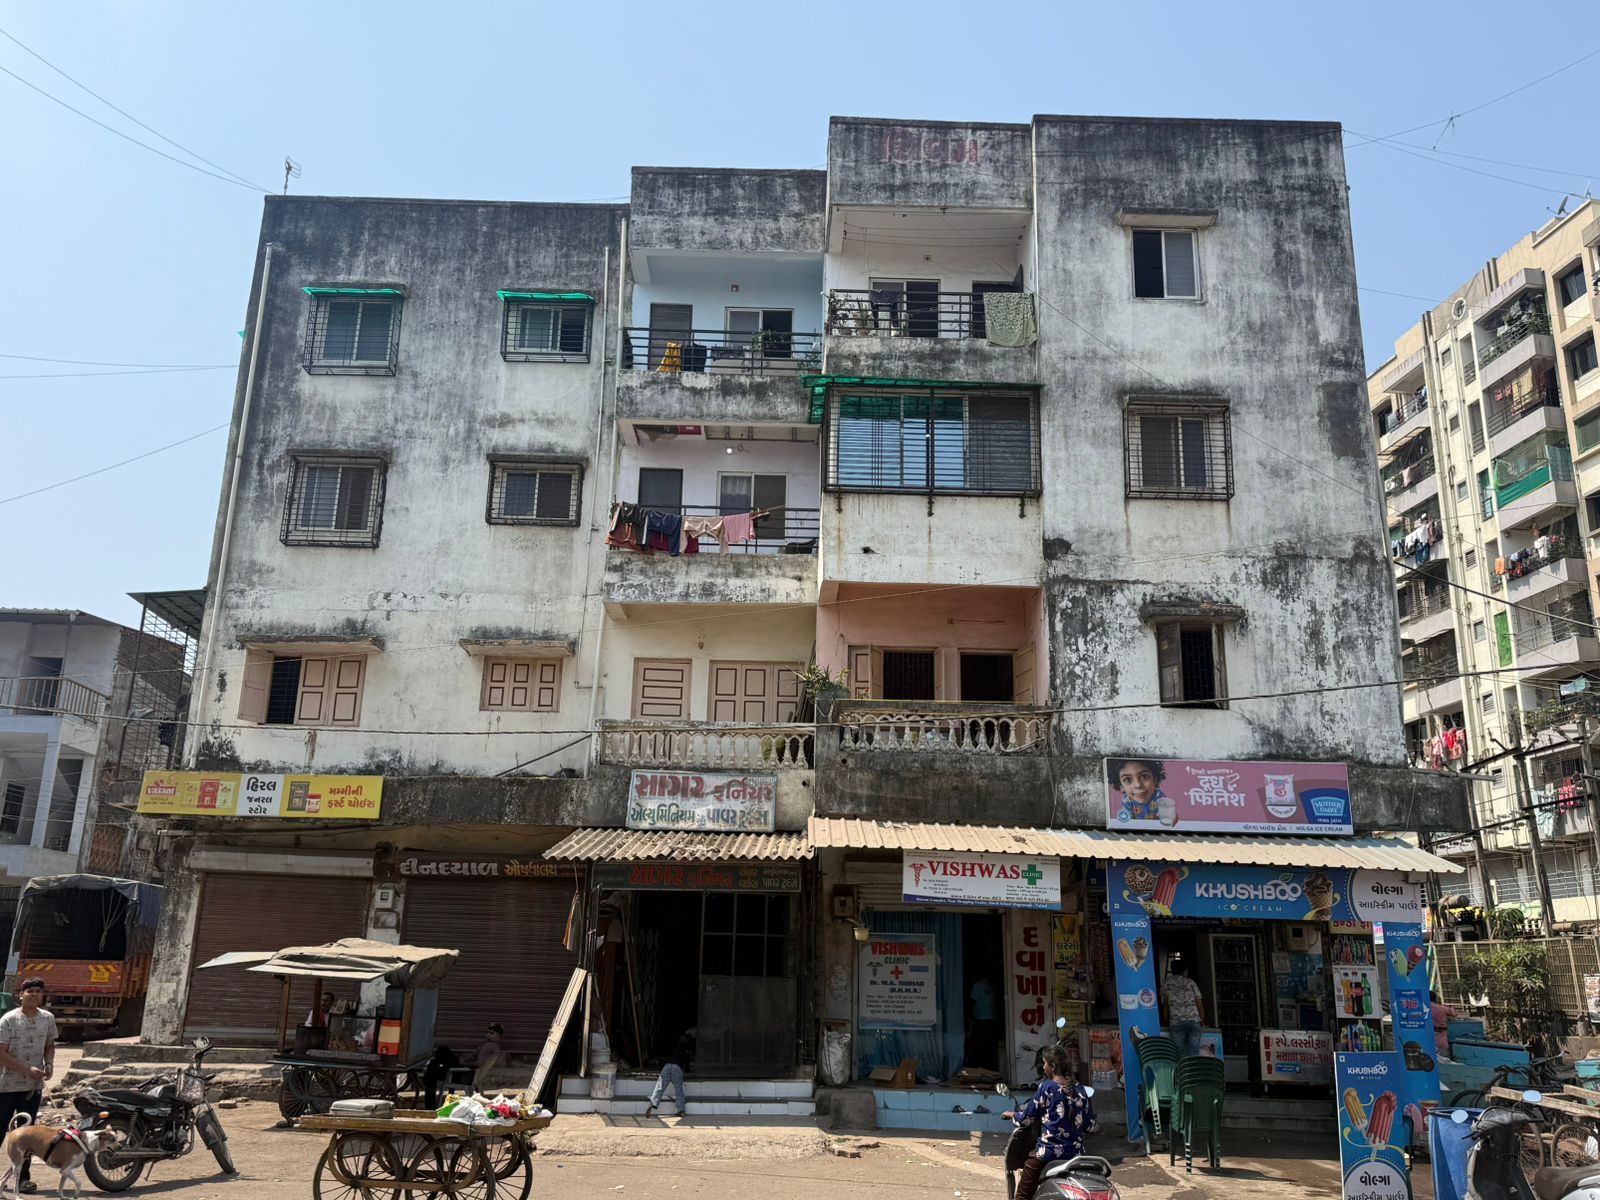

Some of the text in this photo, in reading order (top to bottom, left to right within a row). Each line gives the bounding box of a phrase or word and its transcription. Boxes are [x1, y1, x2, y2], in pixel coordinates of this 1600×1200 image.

[246, 776, 276, 792] હિરલ
[635, 774, 704, 799] સાગર
[329, 785, 363, 796] મમ્મીની
[246, 795, 272, 803] જનરલ
[1314, 800, 1342, 809] MOTHER
[248, 805, 267, 815] સ્ટોર
[399, 857, 499, 876] દીનદયાળ
[927, 860, 1020, 880] VISHWAS
[628, 865, 686, 886] સાગર
[1022, 871, 1043, 879] CLINIC
[1195, 879, 1301, 902] KHUSHBOO
[1371, 882, 1404, 896] વોલ્ગા
[1243, 904, 1282, 912] CREAM
[1114, 919, 1148, 928] KHUSHBOO
[870, 941, 926, 956] VISHWAS
[884, 956, 910, 965] CLINIC
[1347, 1064, 1388, 1075] KHUSHBOO
[1360, 1171, 1391, 1186] વોલ્ગા
